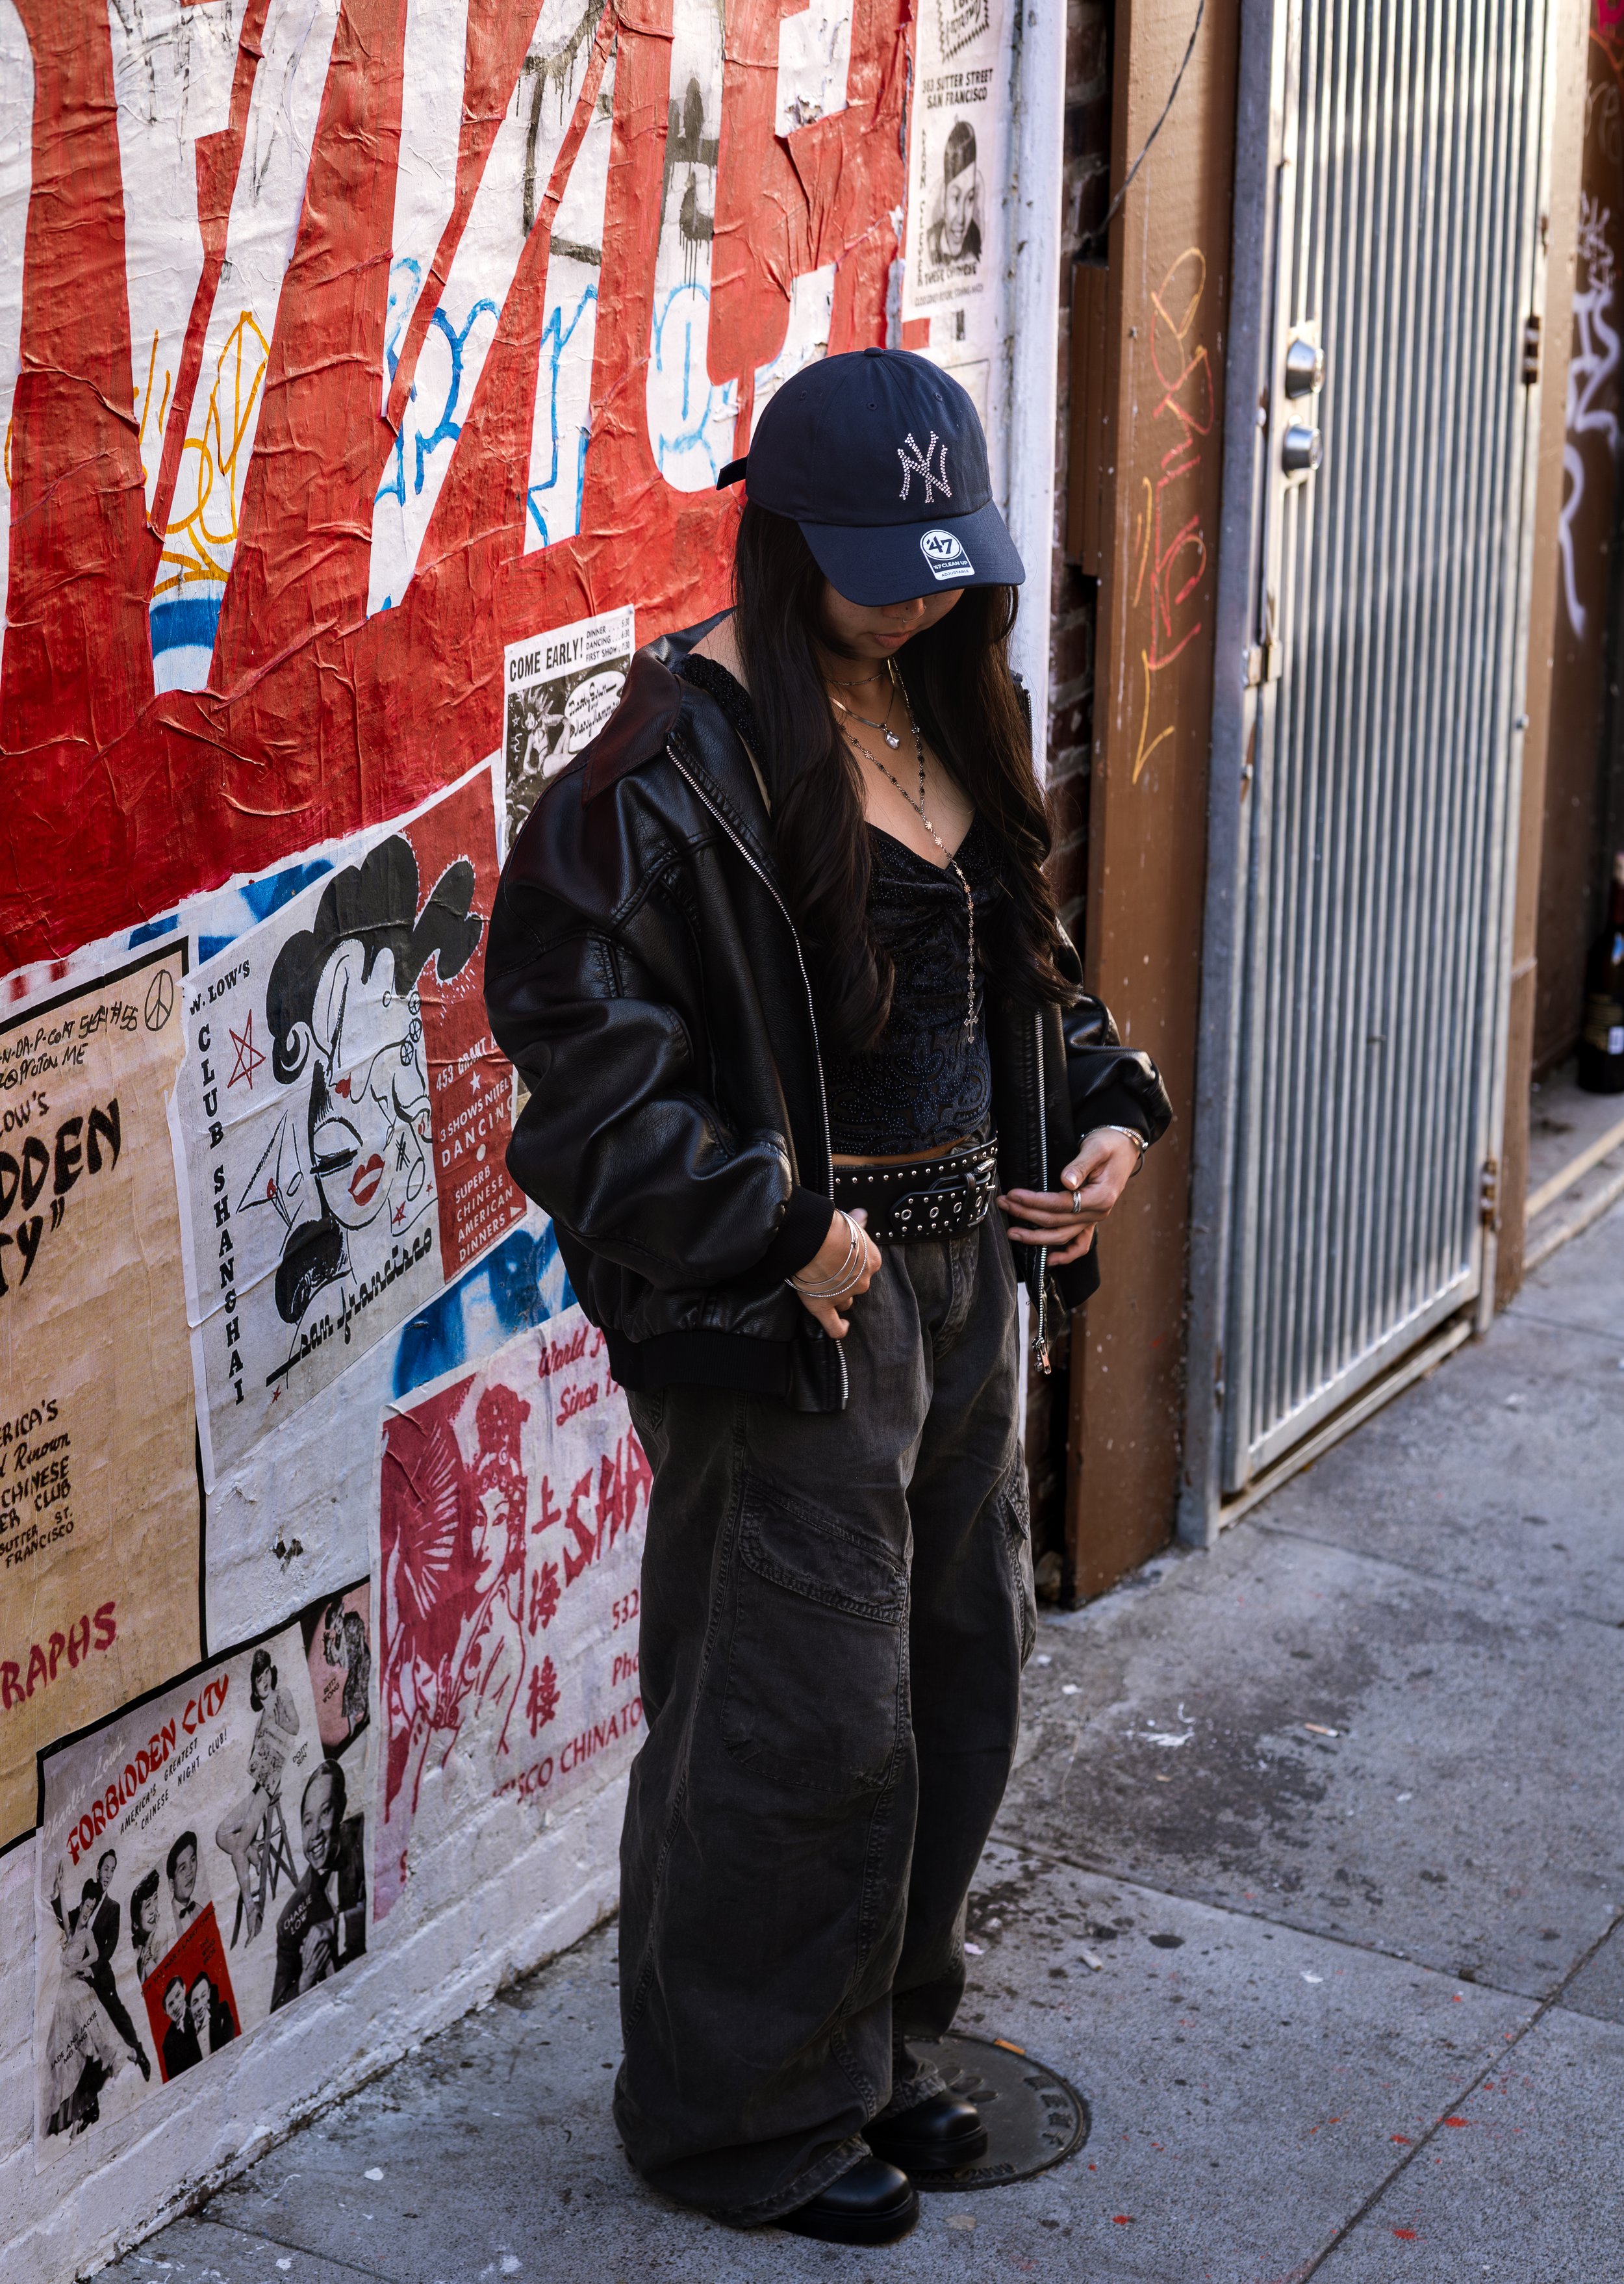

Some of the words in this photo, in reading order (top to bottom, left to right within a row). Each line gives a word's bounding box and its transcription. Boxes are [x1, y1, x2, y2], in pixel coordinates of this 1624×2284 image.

[927, 94, 943, 109] SAN
[945, 87, 987, 106] FRANCISCO
[937, 73, 963, 91] SUTTER
[965, 68, 993, 86] STREET
[896, 430, 953, 504] NY
[586, 635, 611, 650] DANCING
[586, 651, 600, 662] FIRST
[602, 646, 617, 658] SHOW
[587, 625, 606, 639] DINNER
[509, 650, 540, 682] COME
[546, 637, 583, 669] EARLY!
[208, 959, 250, 1004] LOW'S
[435, 1068, 454, 1093] 453
[457, 1039, 488, 1076] GRANT
[440, 1128, 446, 1143] 3
[448, 1100, 485, 1138] SHOWS
[455, 1164, 491, 1205] SUPERB
[457, 1174, 504, 1223] CHINESE
[197, 1023, 224, 1150] CLUB
[213, 1164, 244, 1405] SHANGHAI
[457, 1186, 513, 1244] AMERICAN
[458, 1213, 506, 1263] DINNERS
[538, 1324, 589, 1379] World
[556, 1381, 599, 1426] Since
[1, 1456, 70, 1508] CHINESE
[34, 1478, 71, 1512] CLUB
[5, 1521, 74, 1569] FRANCISCO
[612, 1588, 639, 1630] 532
[0, 1601, 118, 1712] RAPHS
[322, 1682, 340, 1703] WONG
[323, 1678, 336, 1695] BETTY
[66, 1717, 177, 1866] FORBIDDEN
[182, 1673, 229, 1736] CITY
[120, 1783, 157, 1836] AMERICA'S
[164, 1737, 198, 1782] GREATEST
[141, 1789, 170, 1830] CHINESE
[177, 1756, 201, 1787] NIGHT
[208, 1728, 227, 1757] CLUB!
[283, 1893, 312, 1931] CHARLIE
[290, 1911, 308, 1936] LOW
[51, 2051, 65, 2071] JADE
[66, 2032, 79, 2053] AND
[80, 2010, 98, 2034] JACKIE
[73, 2031, 89, 2051] LING
